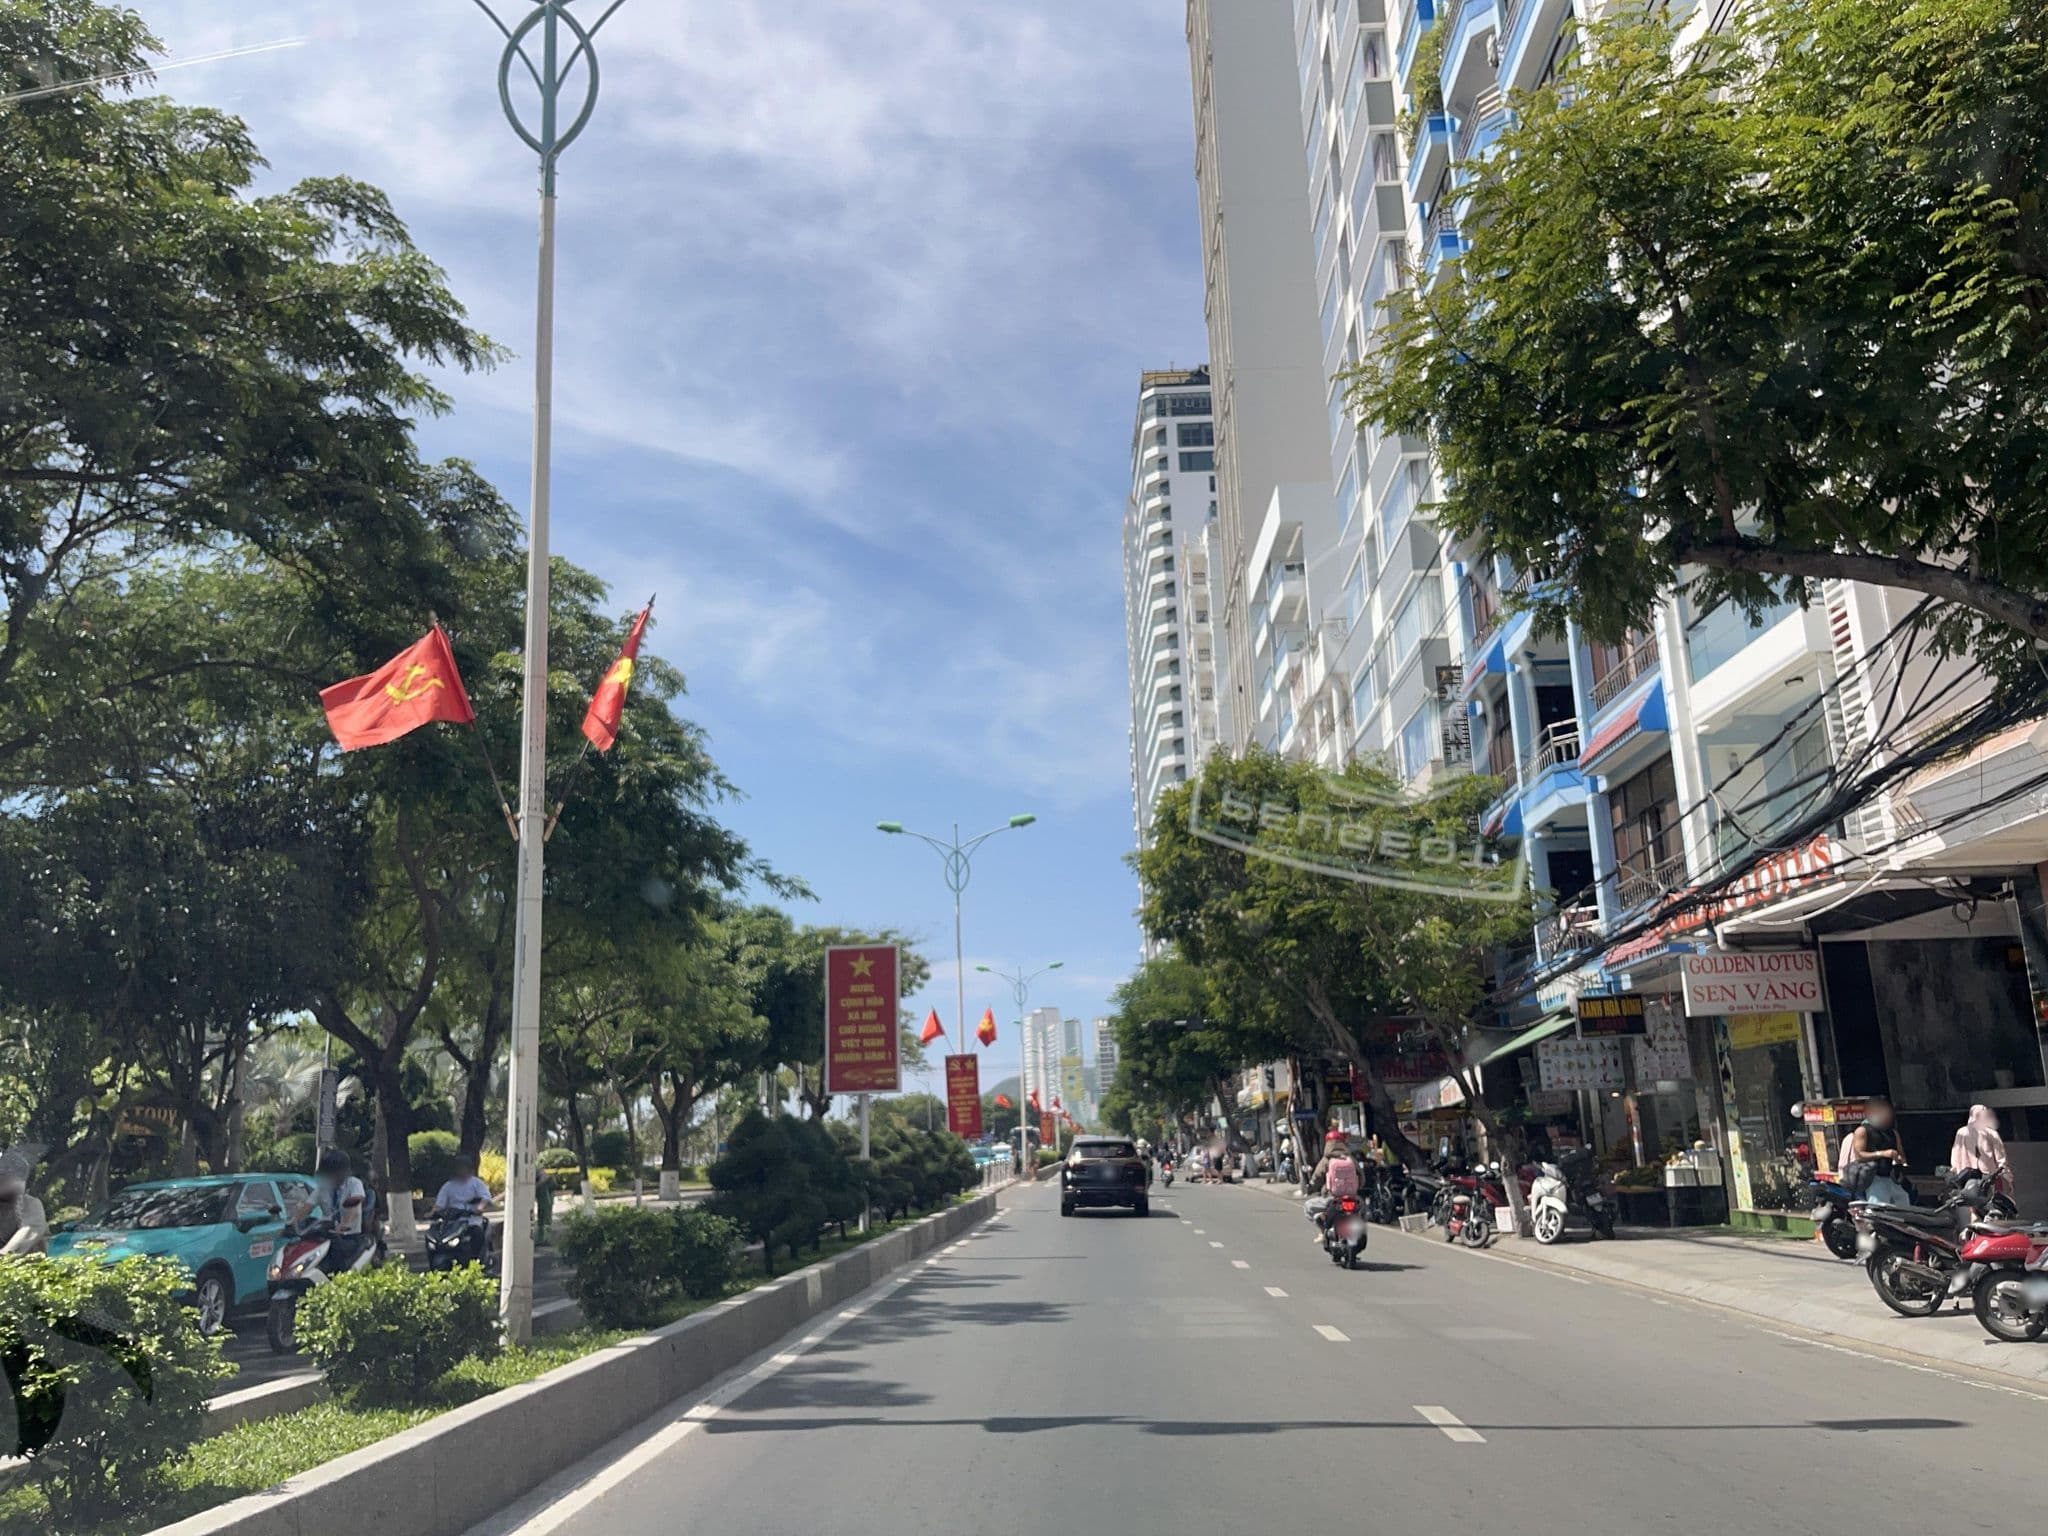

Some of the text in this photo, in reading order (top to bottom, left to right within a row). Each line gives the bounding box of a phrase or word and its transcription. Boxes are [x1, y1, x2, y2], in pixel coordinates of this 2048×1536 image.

[1689, 952, 1814, 975] GOLDEN LOTUS
[1692, 977, 1817, 1003] SEN VÀNG
